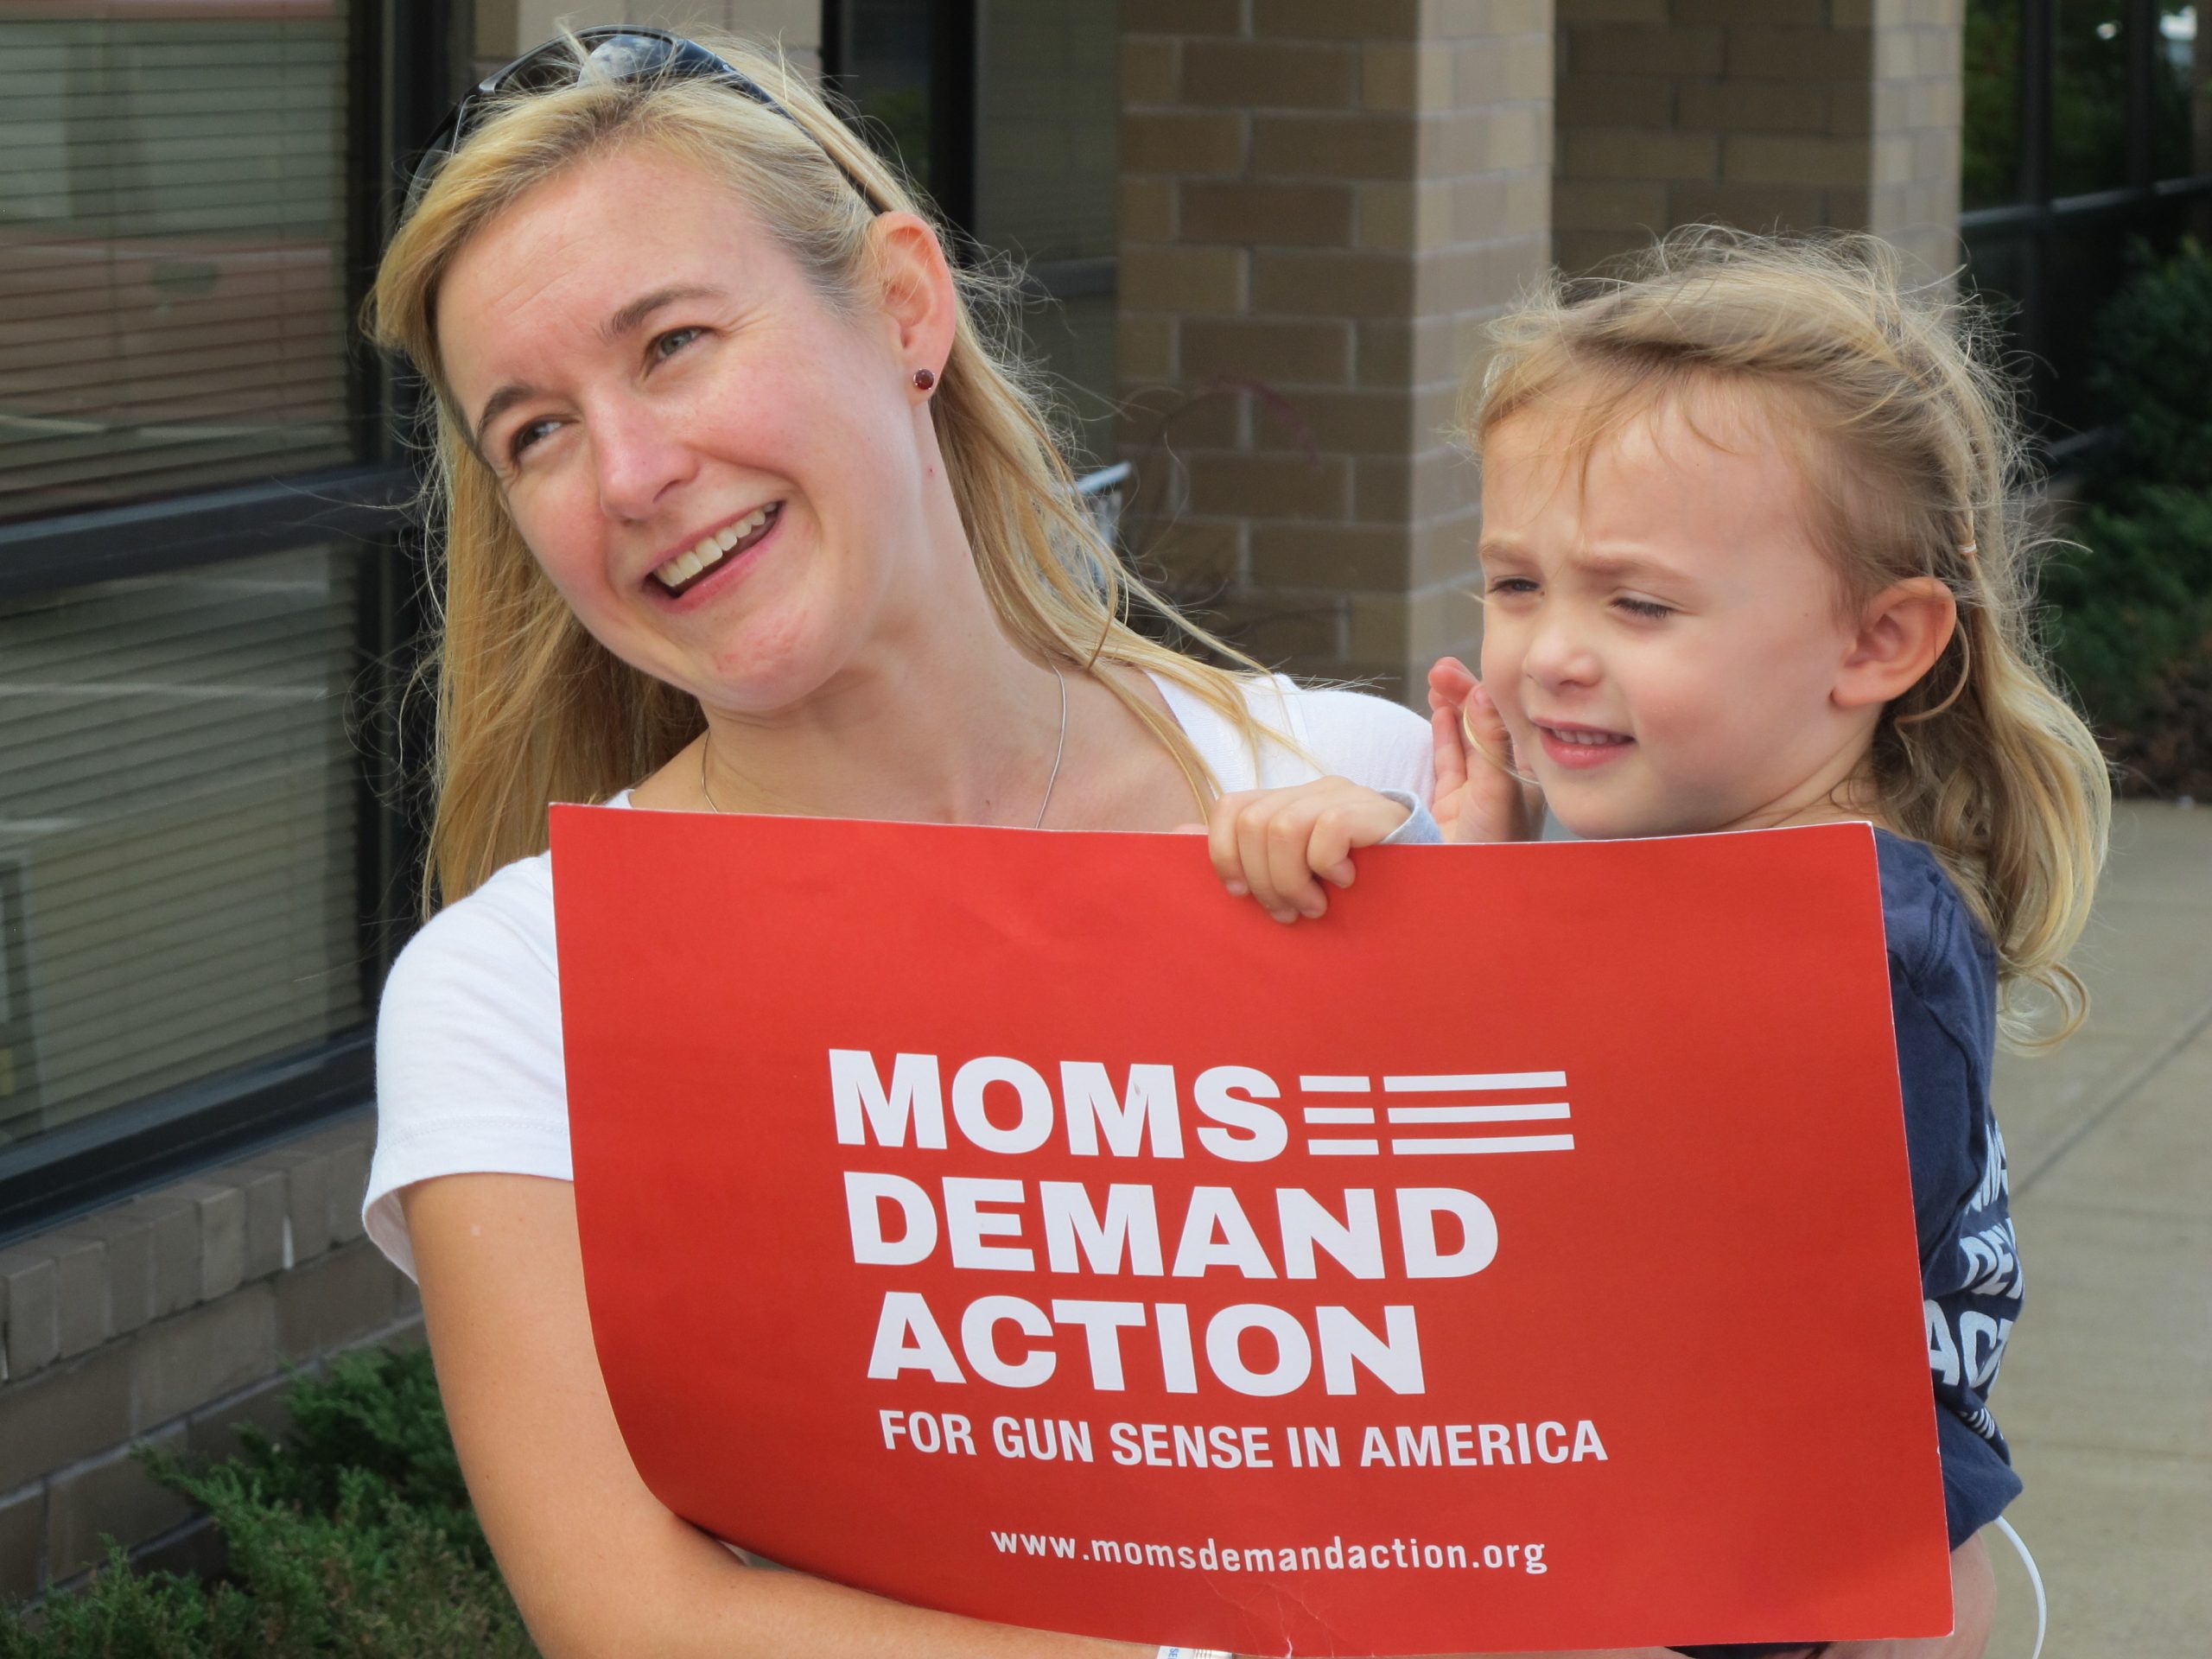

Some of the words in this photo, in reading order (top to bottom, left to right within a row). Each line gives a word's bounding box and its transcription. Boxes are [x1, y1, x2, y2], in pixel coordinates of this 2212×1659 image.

[829, 1048, 1288, 1162] MOMS
[843, 1171, 1498, 1280] DEMAND
[867, 1291, 1426, 1397] ACTION
[879, 1409, 976, 1455] FOR
[993, 1416, 1094, 1463] GUN
[1109, 1422, 1274, 1469] SENSE
[1287, 1427, 1341, 1467] IN
[1360, 1420, 1608, 1467] AMERICA
[991, 1531, 1548, 1574] www.momsdemandaction.org
